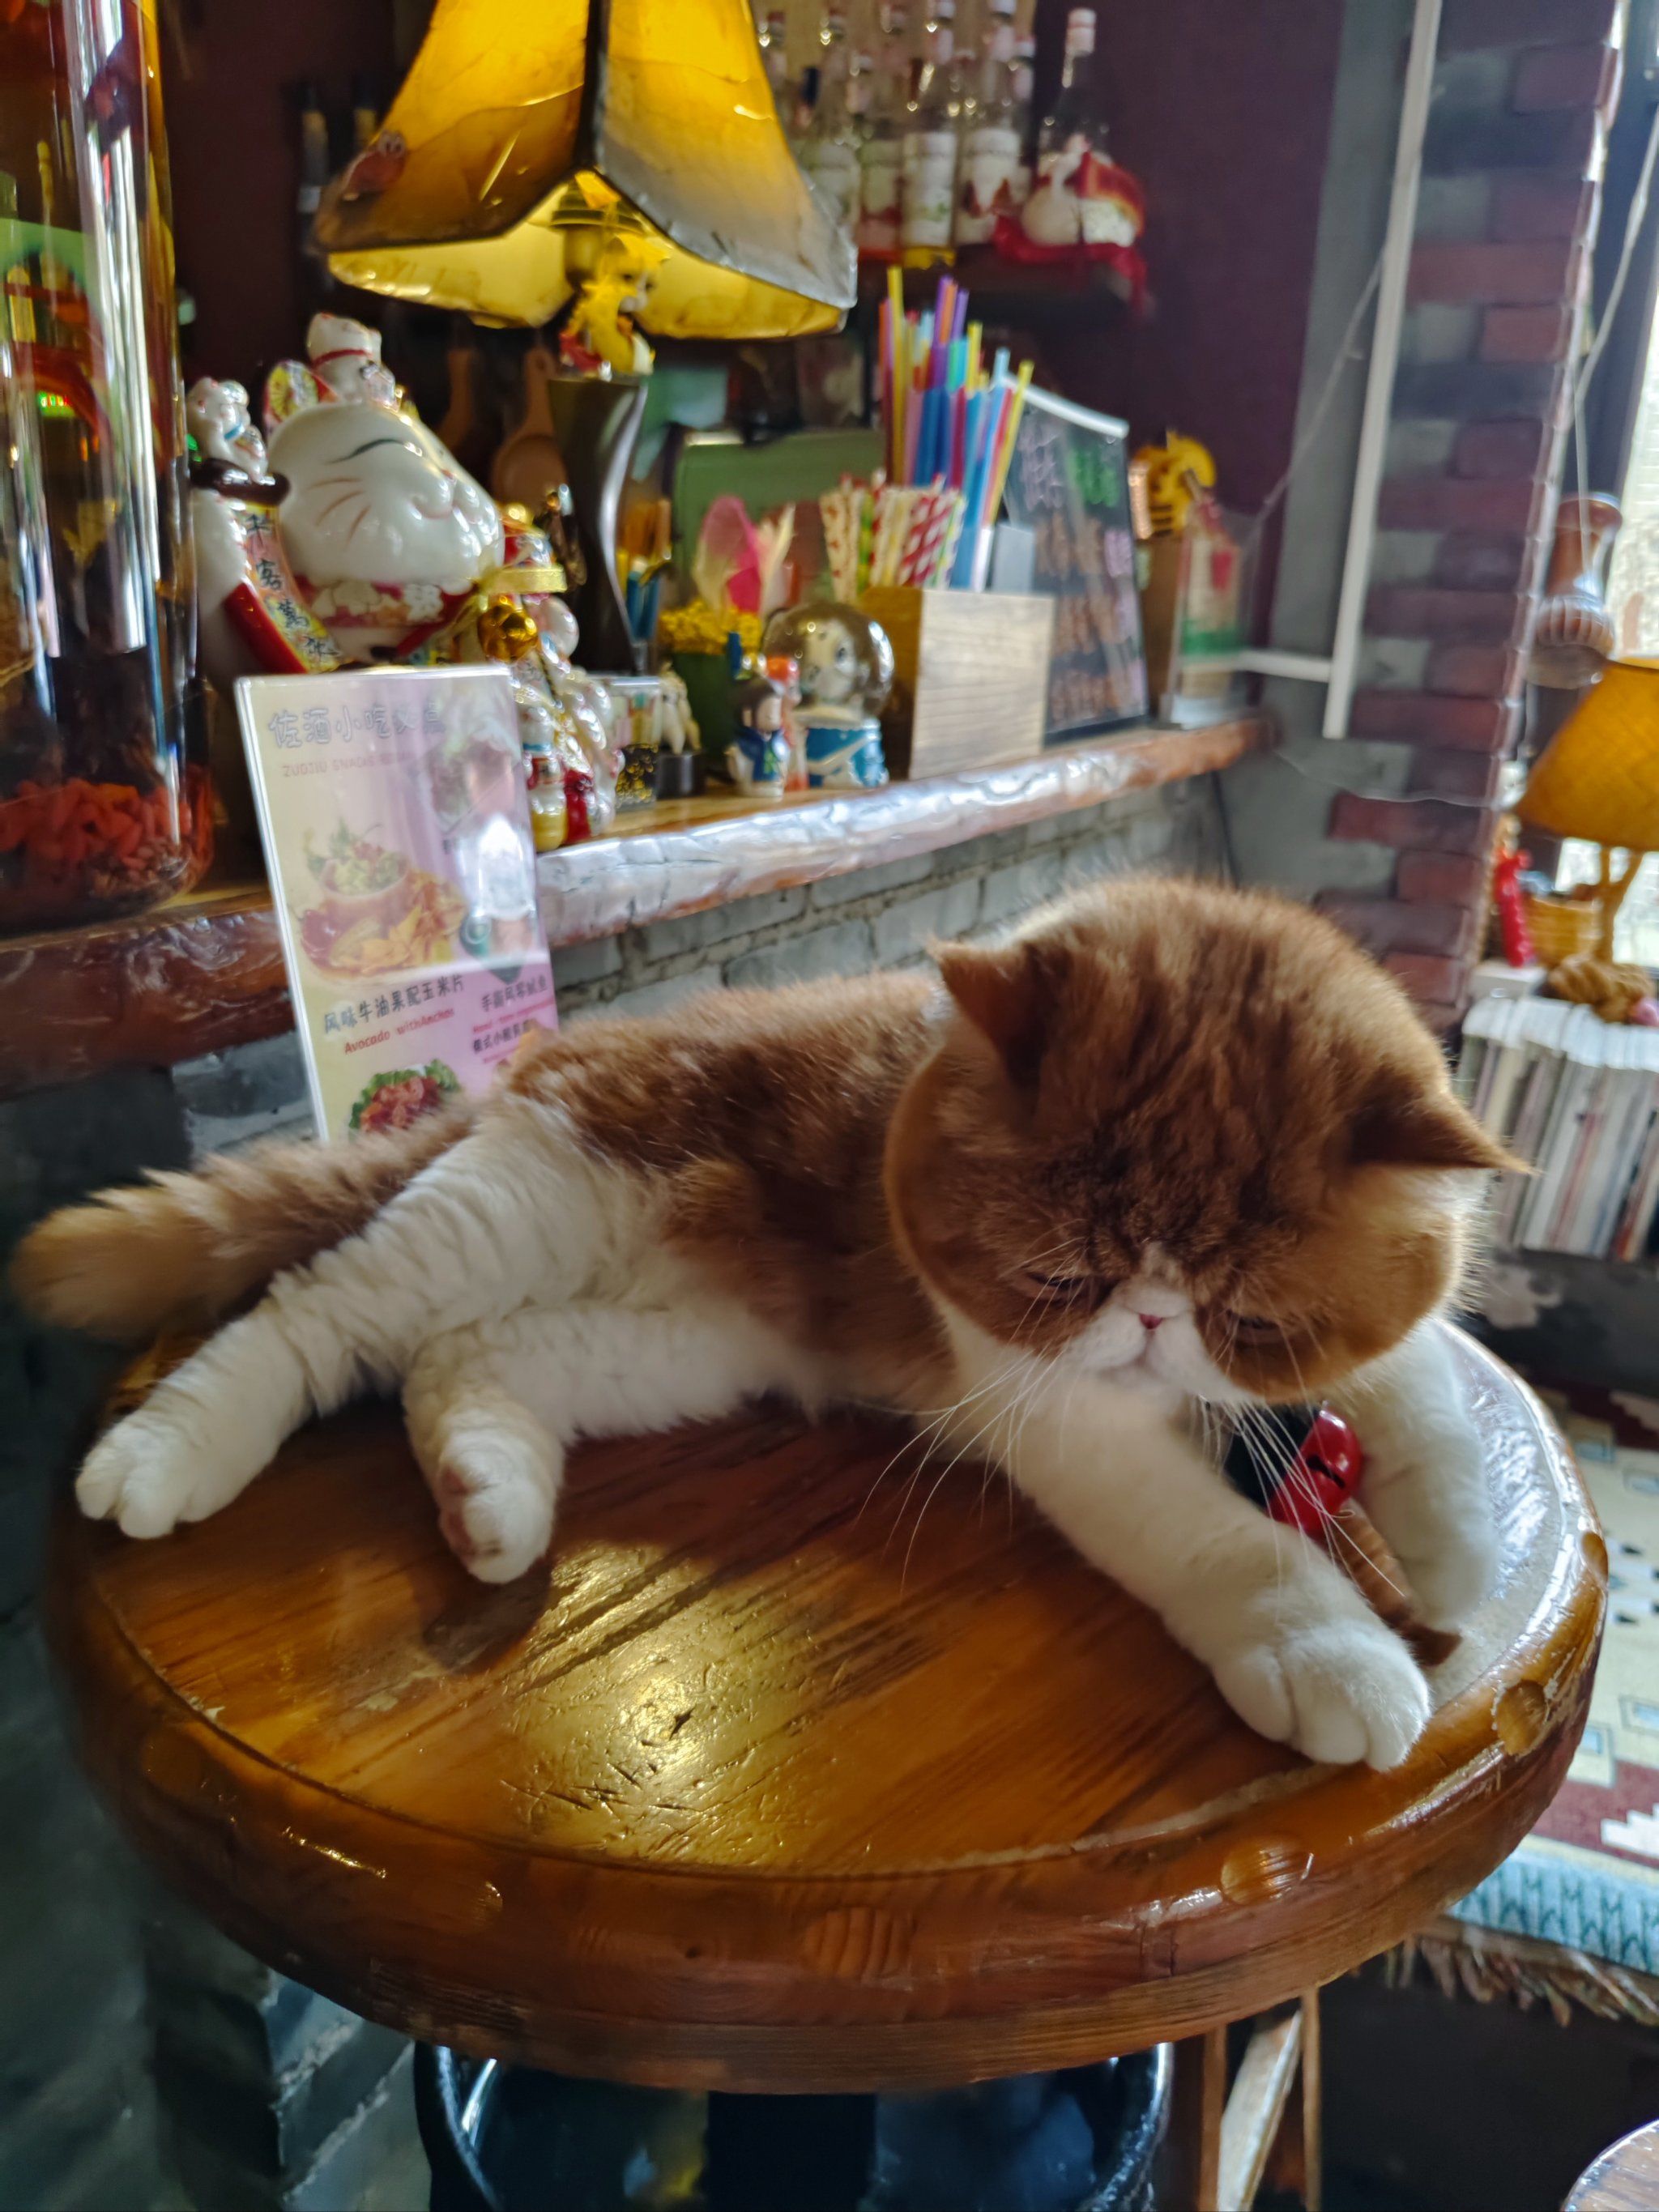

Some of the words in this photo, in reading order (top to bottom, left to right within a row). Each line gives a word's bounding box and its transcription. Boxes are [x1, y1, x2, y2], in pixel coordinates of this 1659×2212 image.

[323, 974, 464, 1034] 风味牛油果配玉米片
[343, 1029, 391, 1055] Avocado
